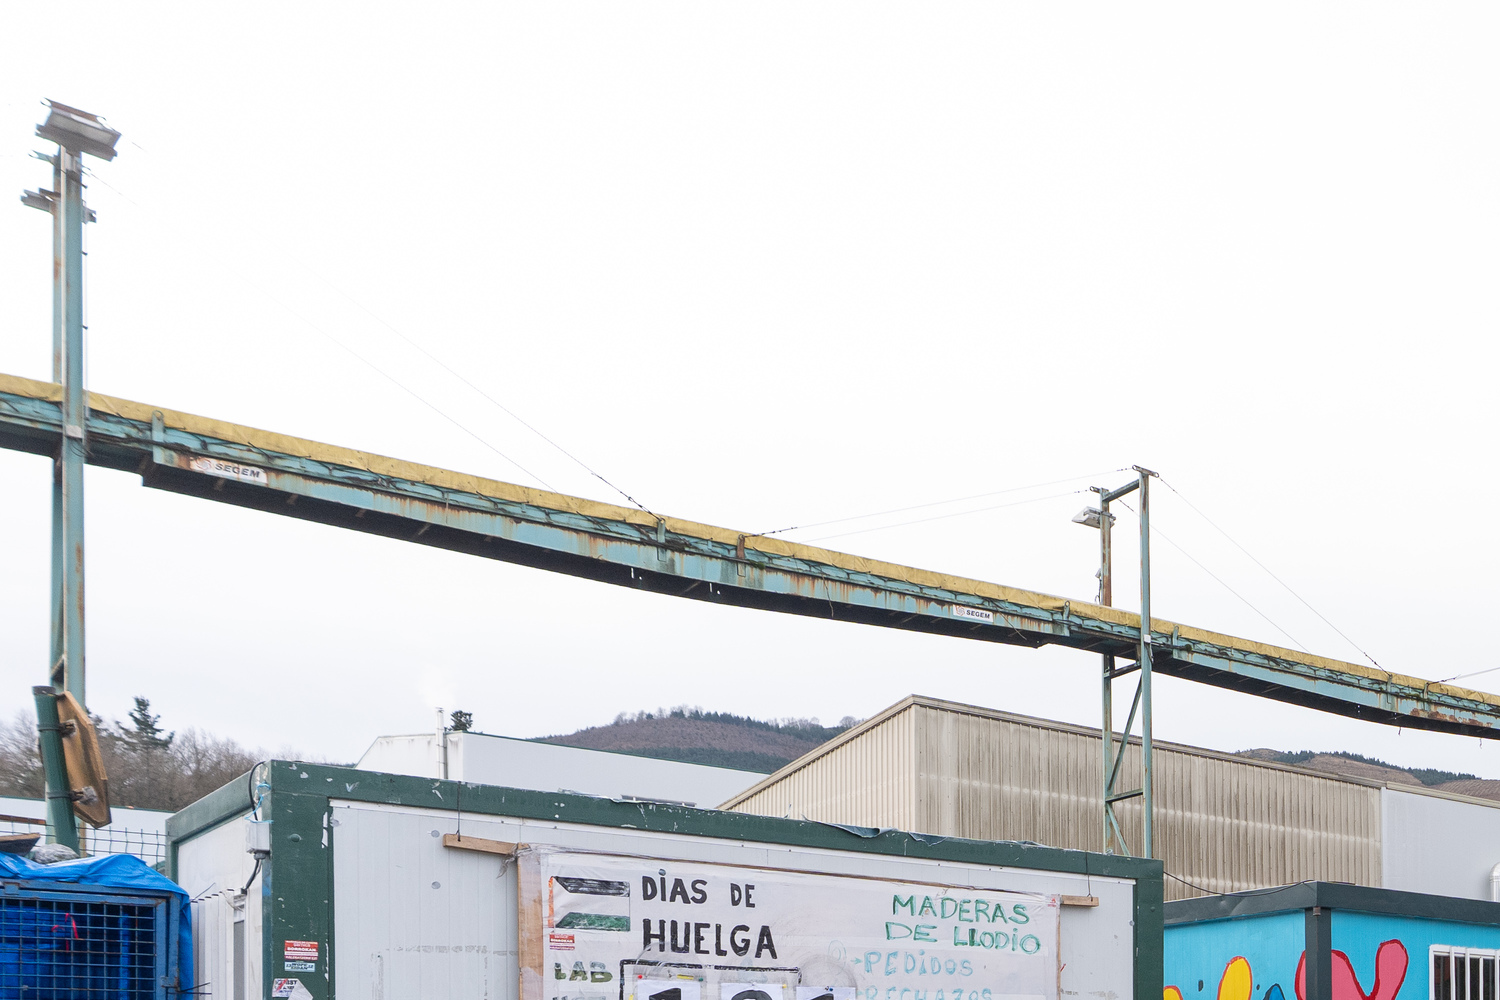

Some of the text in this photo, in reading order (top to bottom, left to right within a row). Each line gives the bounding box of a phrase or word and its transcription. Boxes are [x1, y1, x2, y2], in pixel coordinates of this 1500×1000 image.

[215, 463, 260, 478] SEGEM
[966, 609, 990, 619] SEGEM
[731, 883, 756, 908] DE
[892, 895, 1030, 924] MADERAS
[643, 919, 778, 959] HUELGA
[885, 922, 938, 942] DE
[554, 961, 613, 983] LAB
